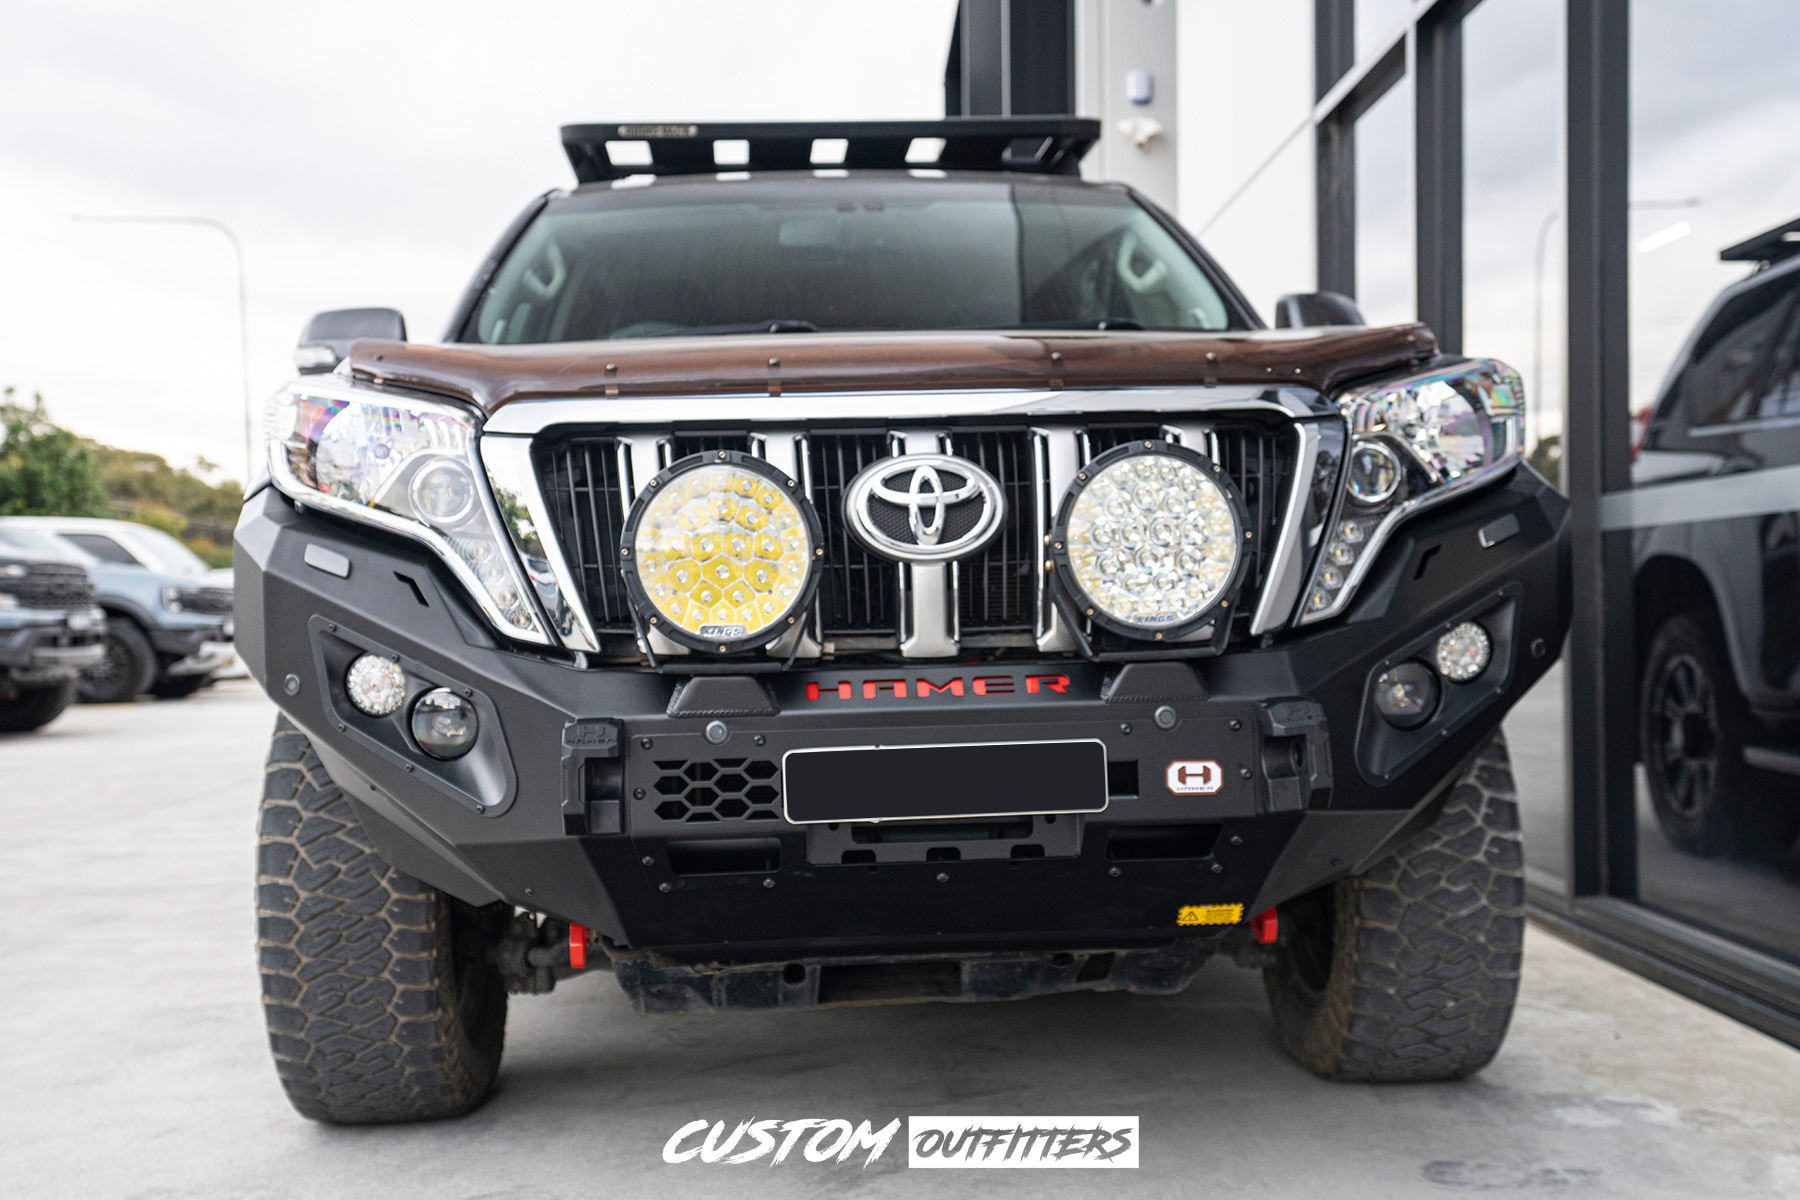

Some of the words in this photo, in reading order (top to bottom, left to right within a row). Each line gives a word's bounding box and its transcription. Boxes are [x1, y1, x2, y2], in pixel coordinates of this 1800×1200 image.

[1137, 614, 1174, 624] KINGS
[703, 627, 742, 637] KINGS
[806, 675, 1071, 700] HAMER
